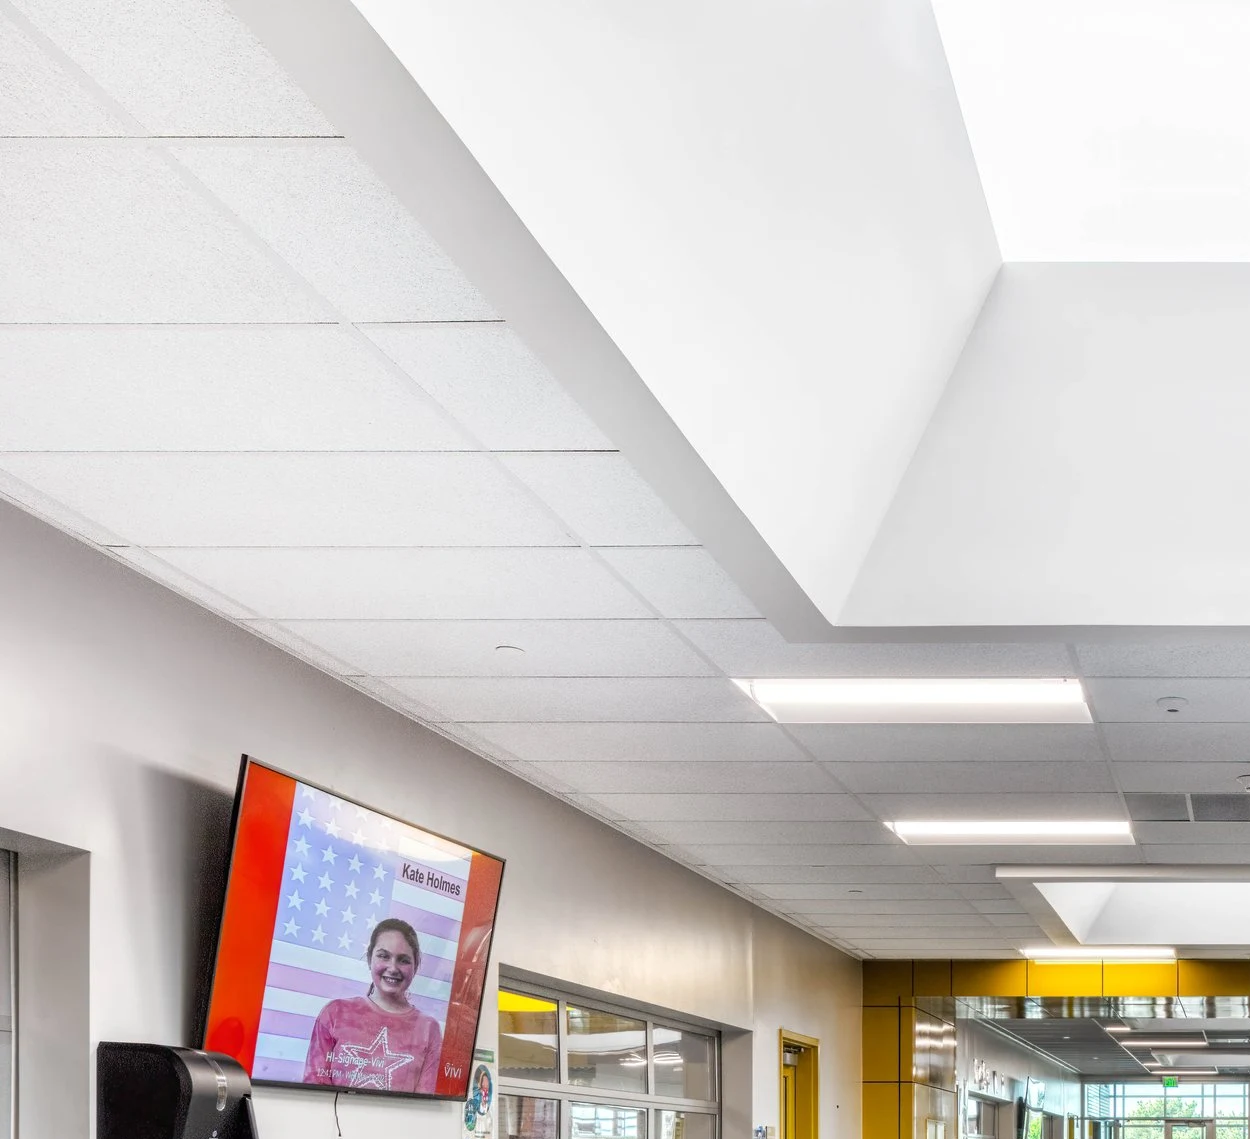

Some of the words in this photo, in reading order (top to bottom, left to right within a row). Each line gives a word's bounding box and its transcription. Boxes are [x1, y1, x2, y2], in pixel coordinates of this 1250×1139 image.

[402, 863, 424, 884] Kate
[426, 871, 461, 896] Holmes
[325, 1051, 385, 1069] HI-Signage-Vivi
